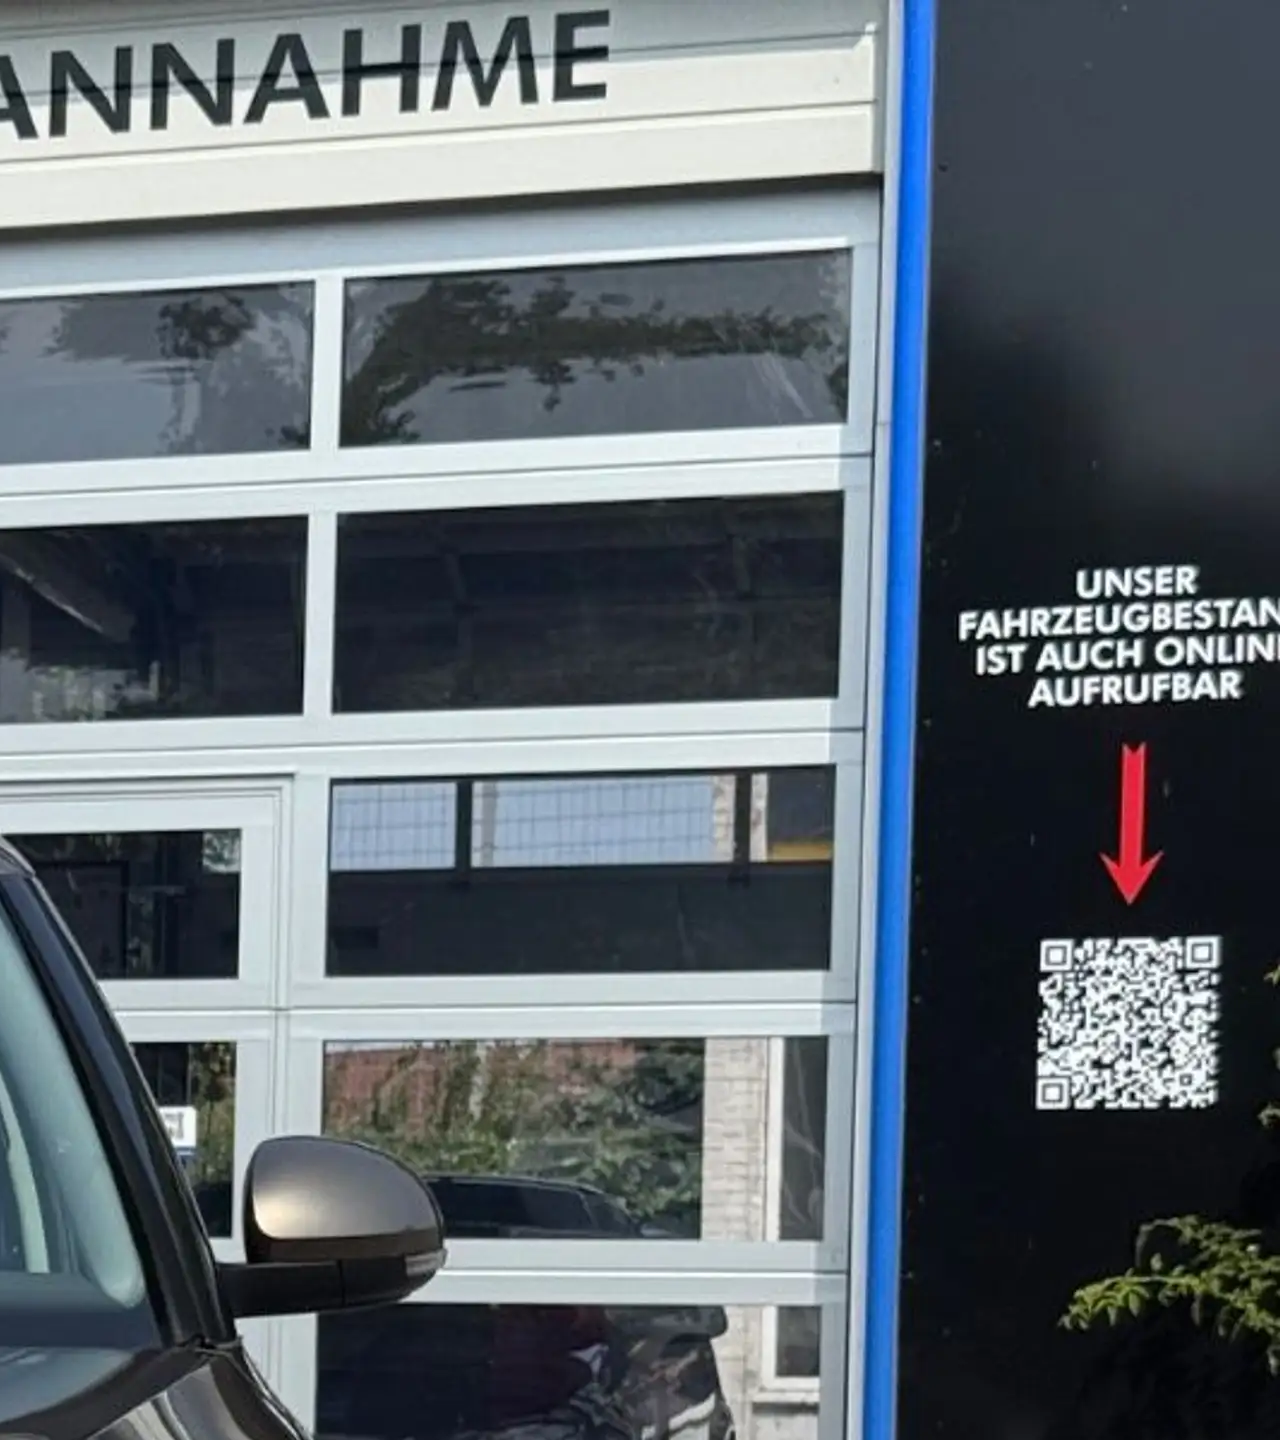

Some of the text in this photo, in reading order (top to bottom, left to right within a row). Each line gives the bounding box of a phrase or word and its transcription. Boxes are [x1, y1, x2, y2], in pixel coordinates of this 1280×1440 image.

[1076, 565, 1198, 599] UNSER
[976, 632, 1280, 675] IST AUCH ONLIN
[1028, 667, 1242, 708] AUFRUFBAR
